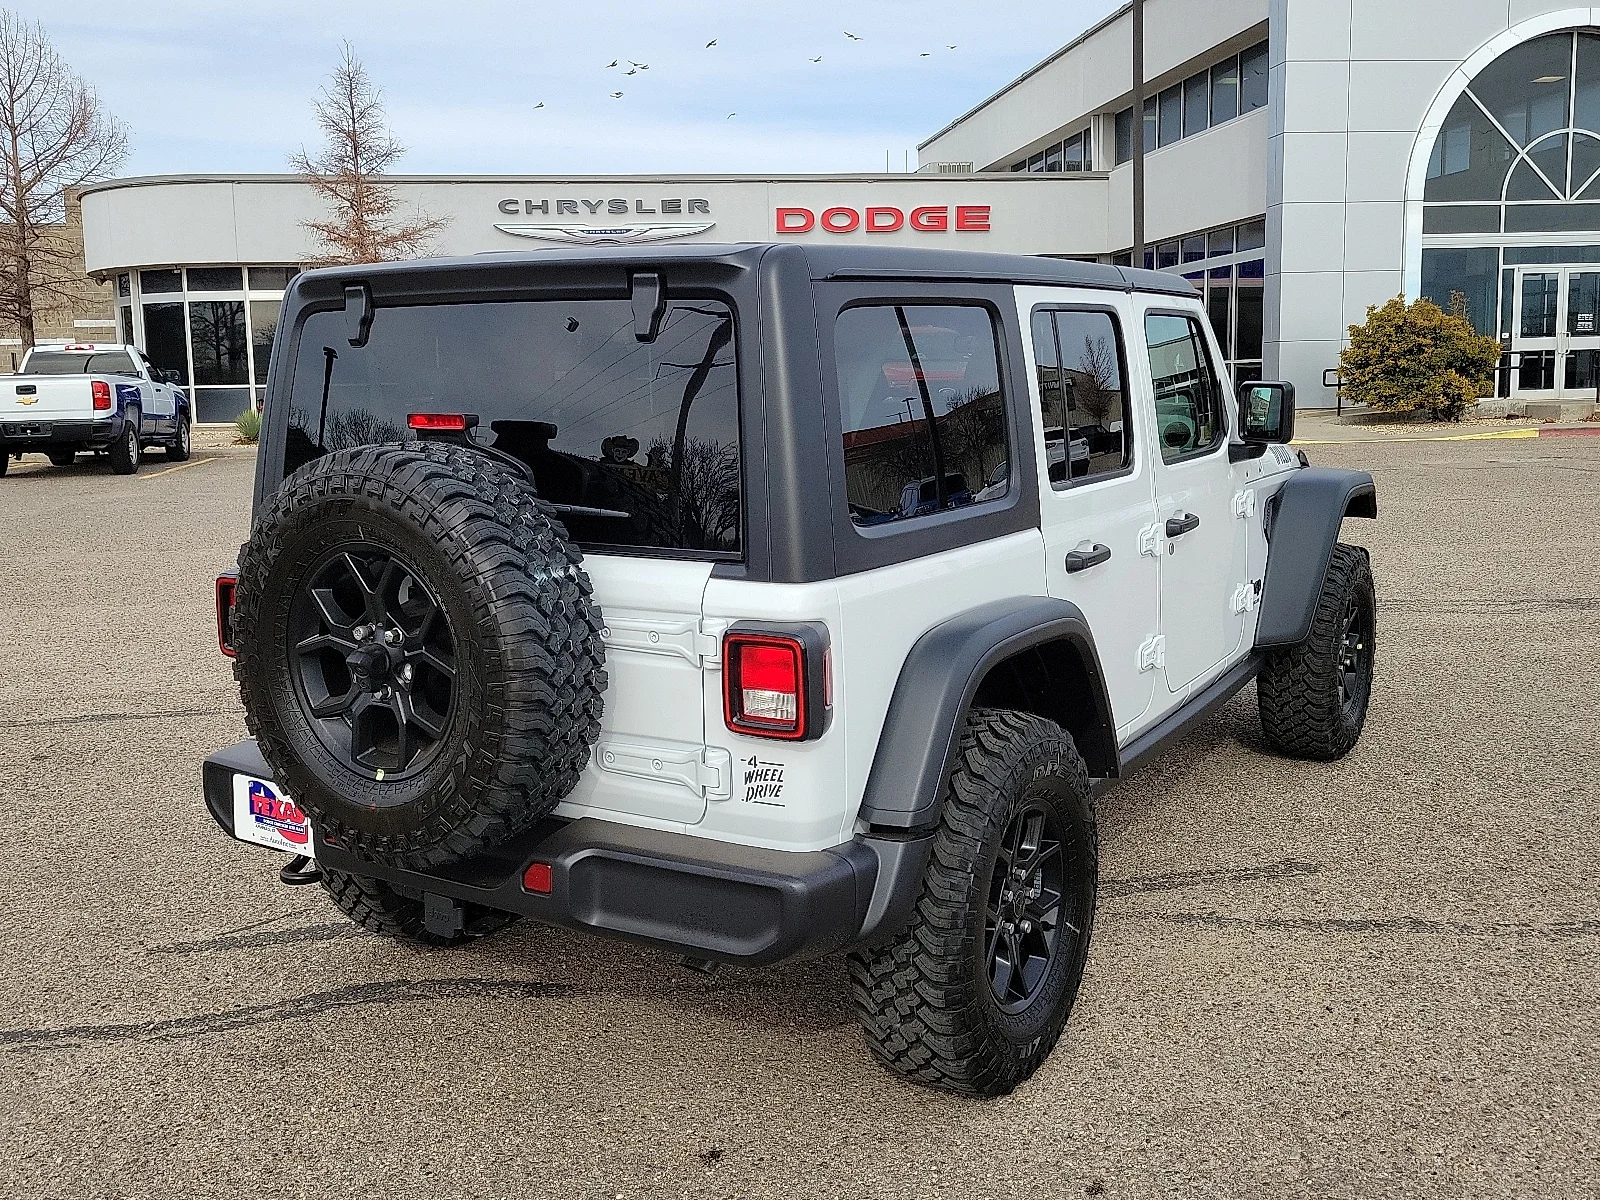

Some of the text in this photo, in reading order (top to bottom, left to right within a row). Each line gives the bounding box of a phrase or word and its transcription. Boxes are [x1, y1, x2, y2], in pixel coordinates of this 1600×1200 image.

[497, 197, 711, 215] CHRYSLER
[774, 204, 992, 234] DODGE
[744, 768, 784, 785] WHEEL
[745, 783, 784, 803] DRIVE
[251, 793, 307, 825] TEXAS
